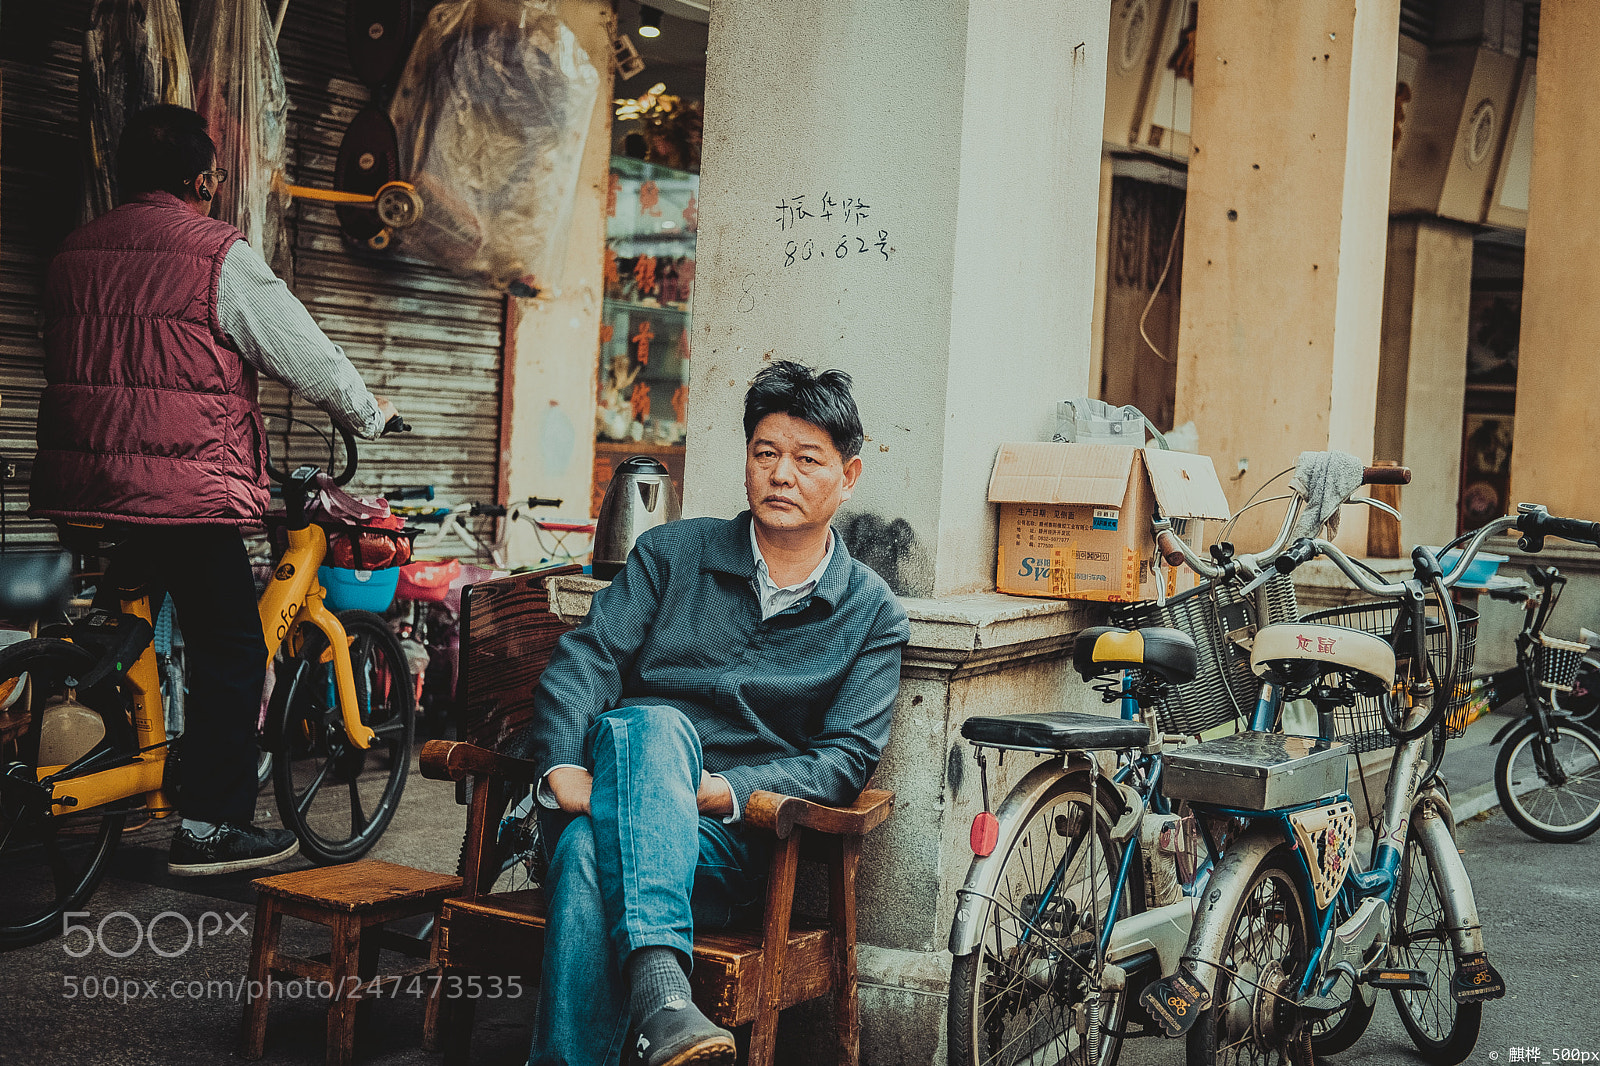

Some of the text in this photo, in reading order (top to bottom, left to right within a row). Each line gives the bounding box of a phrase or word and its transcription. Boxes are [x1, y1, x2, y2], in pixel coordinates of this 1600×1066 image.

[776, 191, 870, 231] 振华路
[277, 602, 297, 641] ofo
